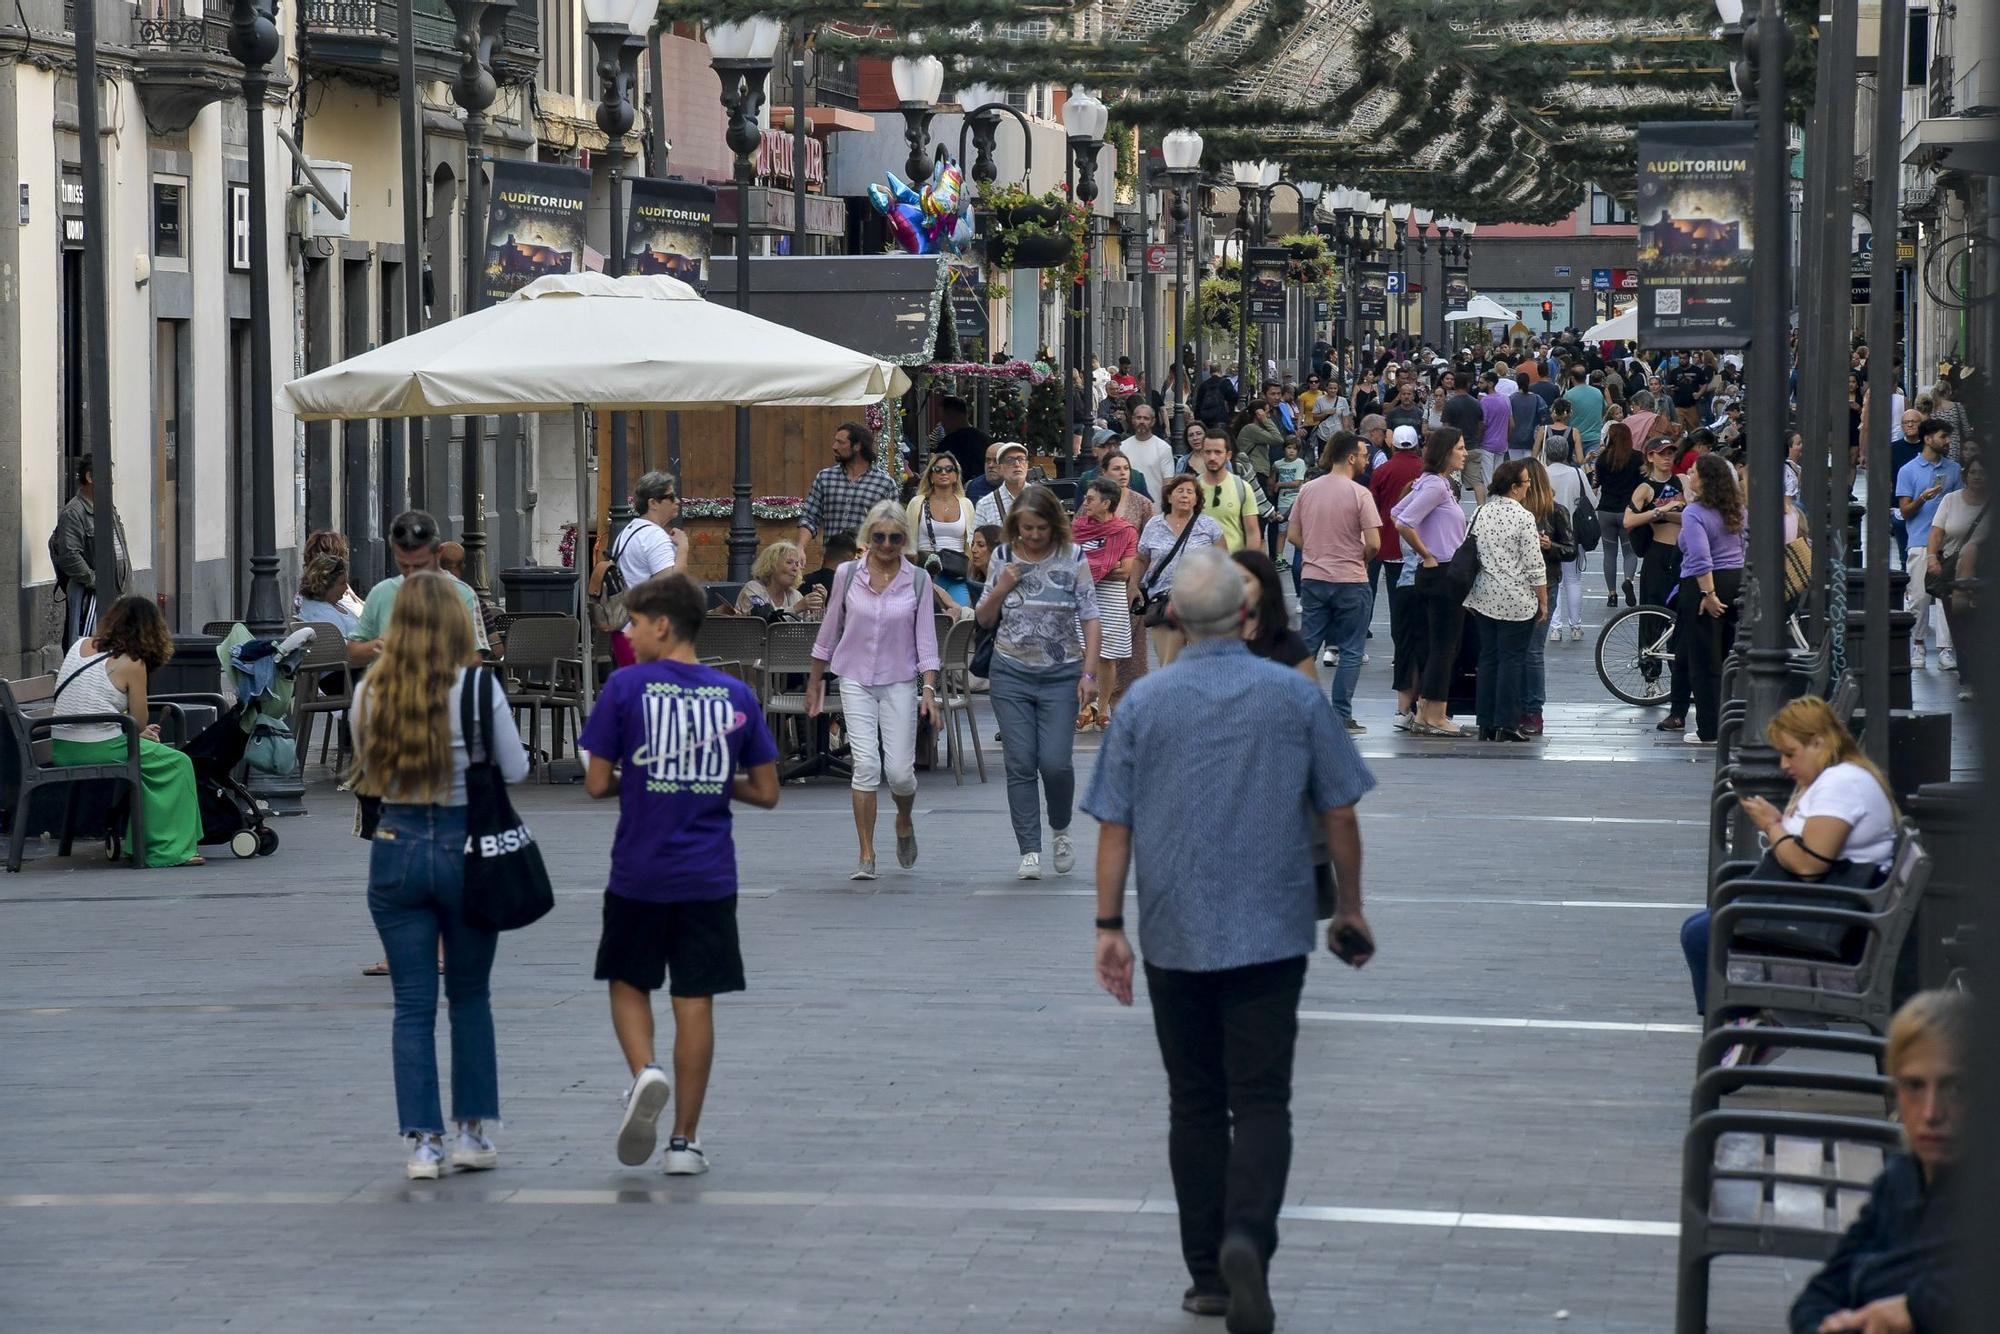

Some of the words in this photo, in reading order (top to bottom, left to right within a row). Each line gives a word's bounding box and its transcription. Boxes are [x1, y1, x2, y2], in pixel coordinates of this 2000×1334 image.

[1647, 160, 1747, 173] AUDITORIUM
[500, 191, 584, 211] AUDITORIUM
[637, 206, 711, 222] AUDITORIUM
[1387, 275, 1399, 290] P
[642, 693, 734, 782] VANS
